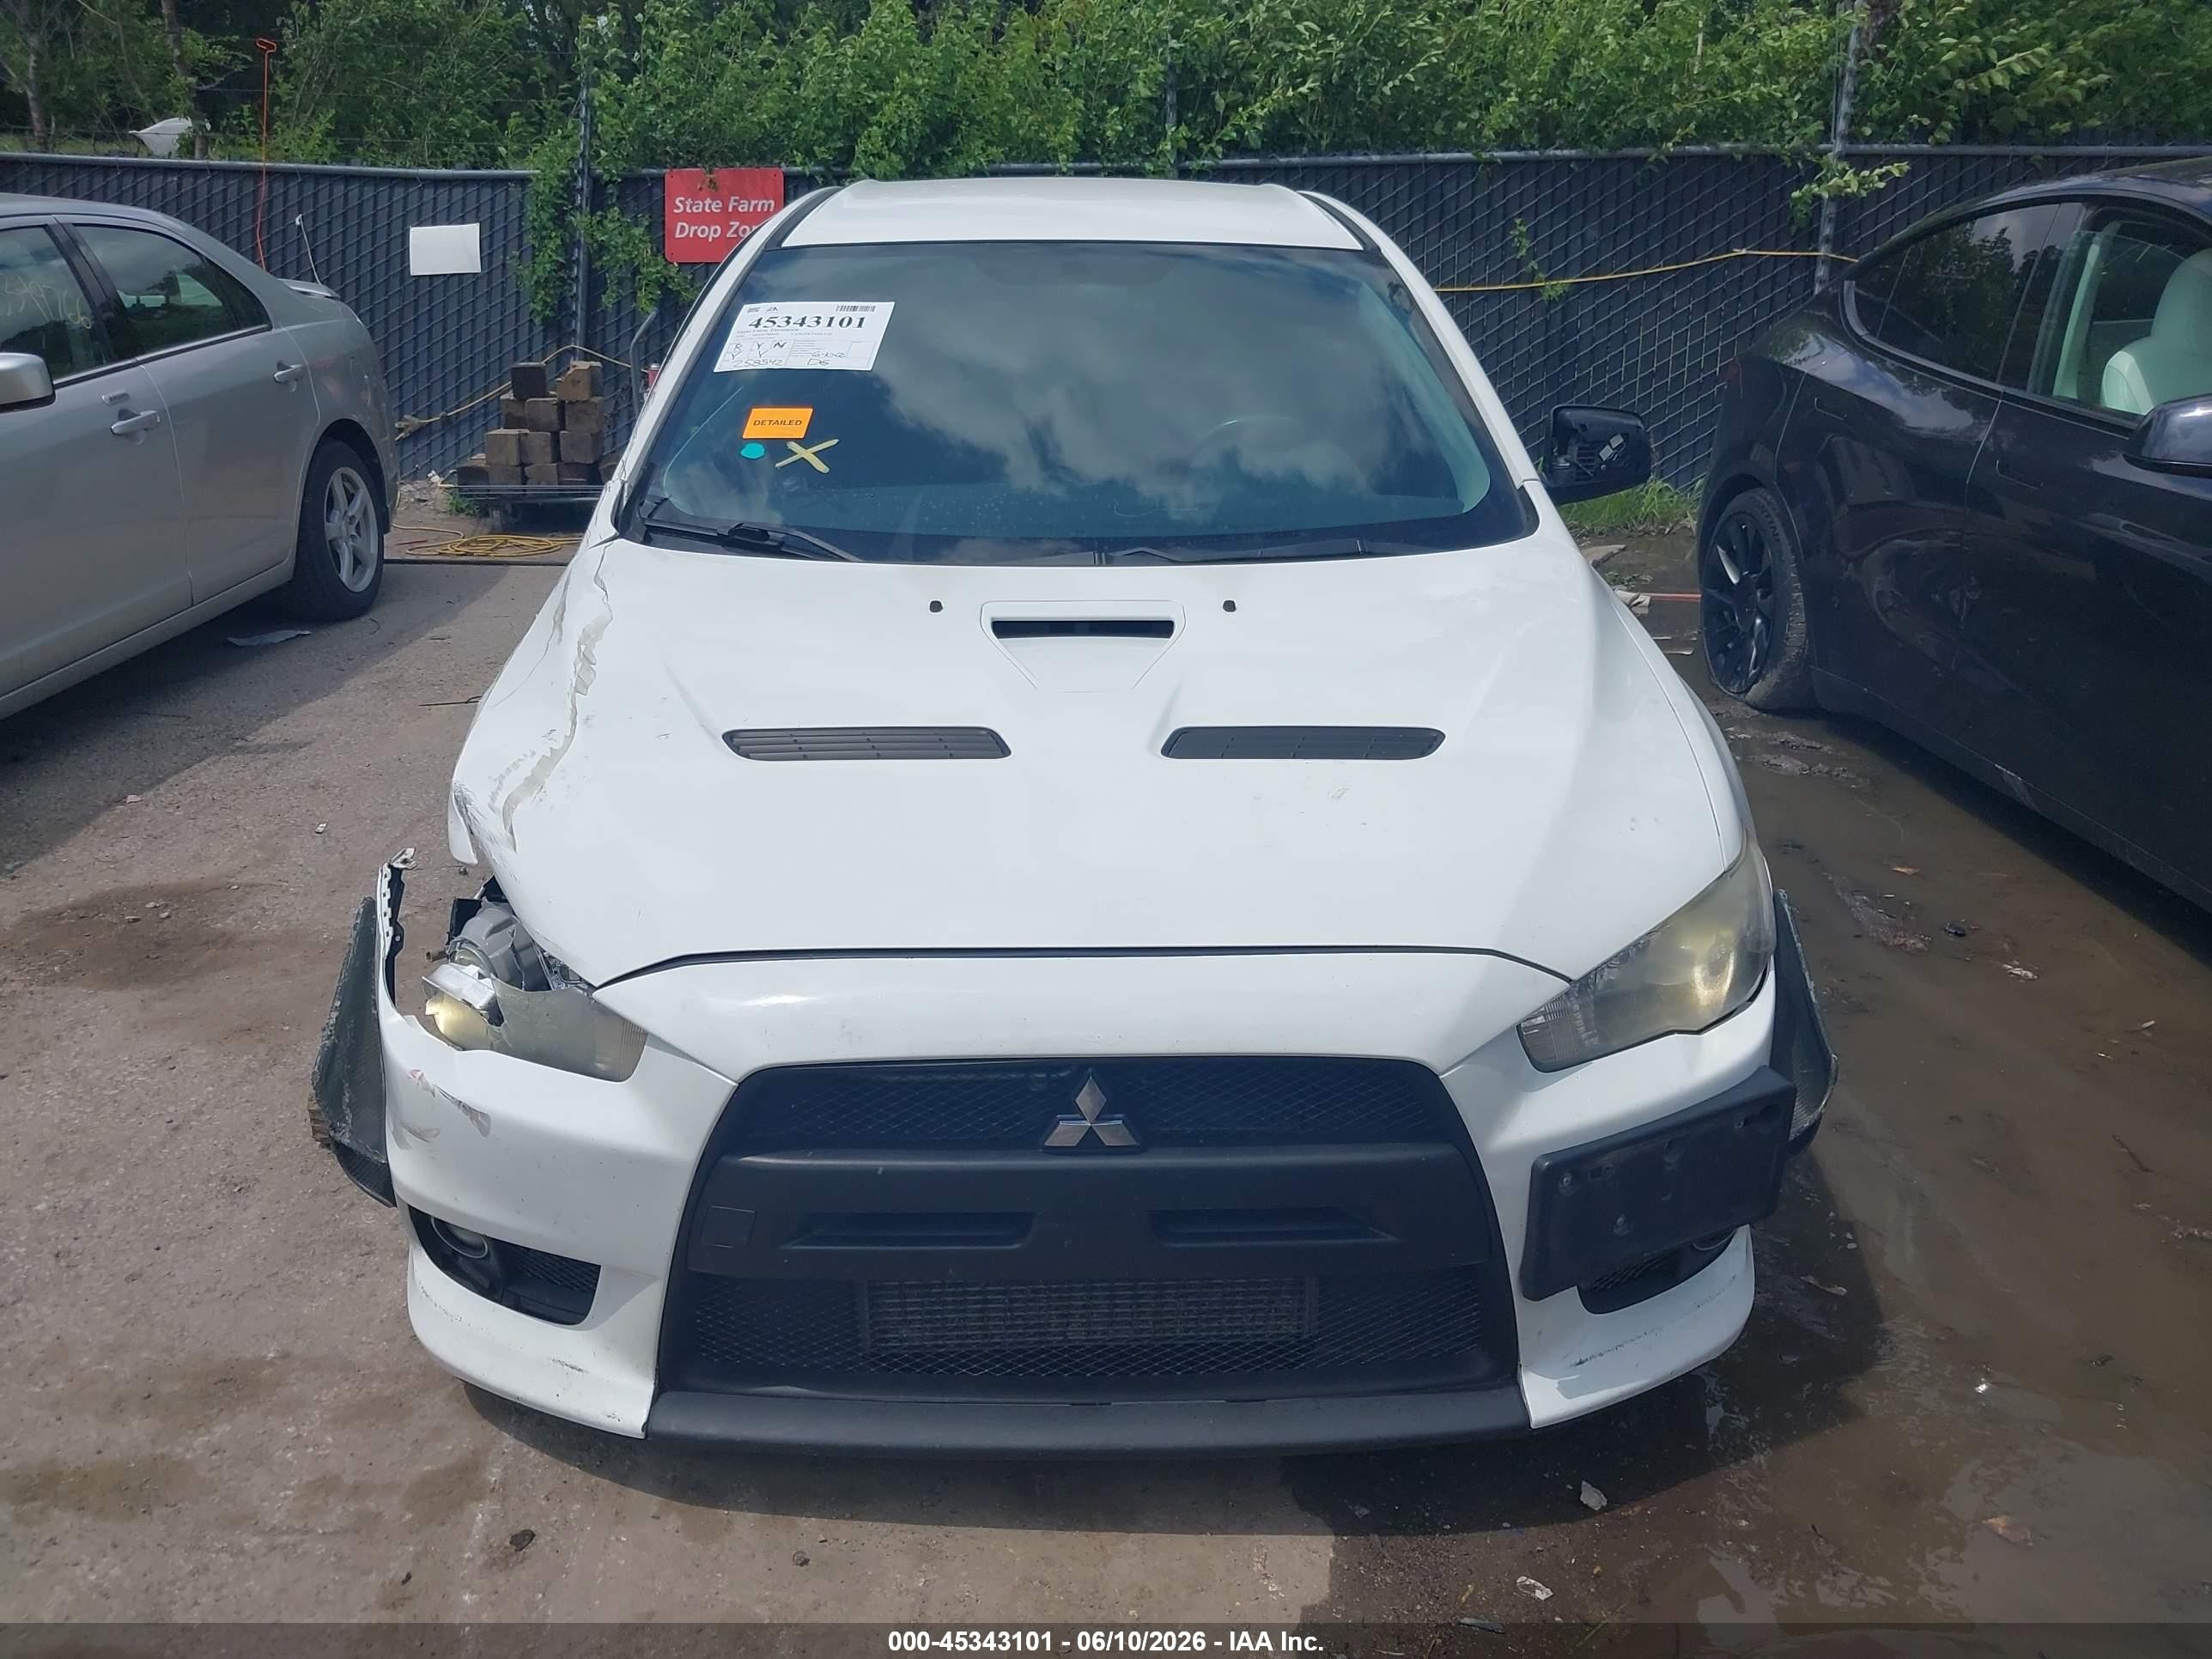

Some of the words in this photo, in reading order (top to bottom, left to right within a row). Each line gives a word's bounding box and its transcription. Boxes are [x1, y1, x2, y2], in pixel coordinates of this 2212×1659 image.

[673, 197, 722, 213] State
[728, 197, 775, 212] Farm
[675, 222, 721, 242] Drop
[726, 222, 757, 238] Zo
[748, 316, 866, 329] 45343101
[753, 418, 803, 427] DETAILED
